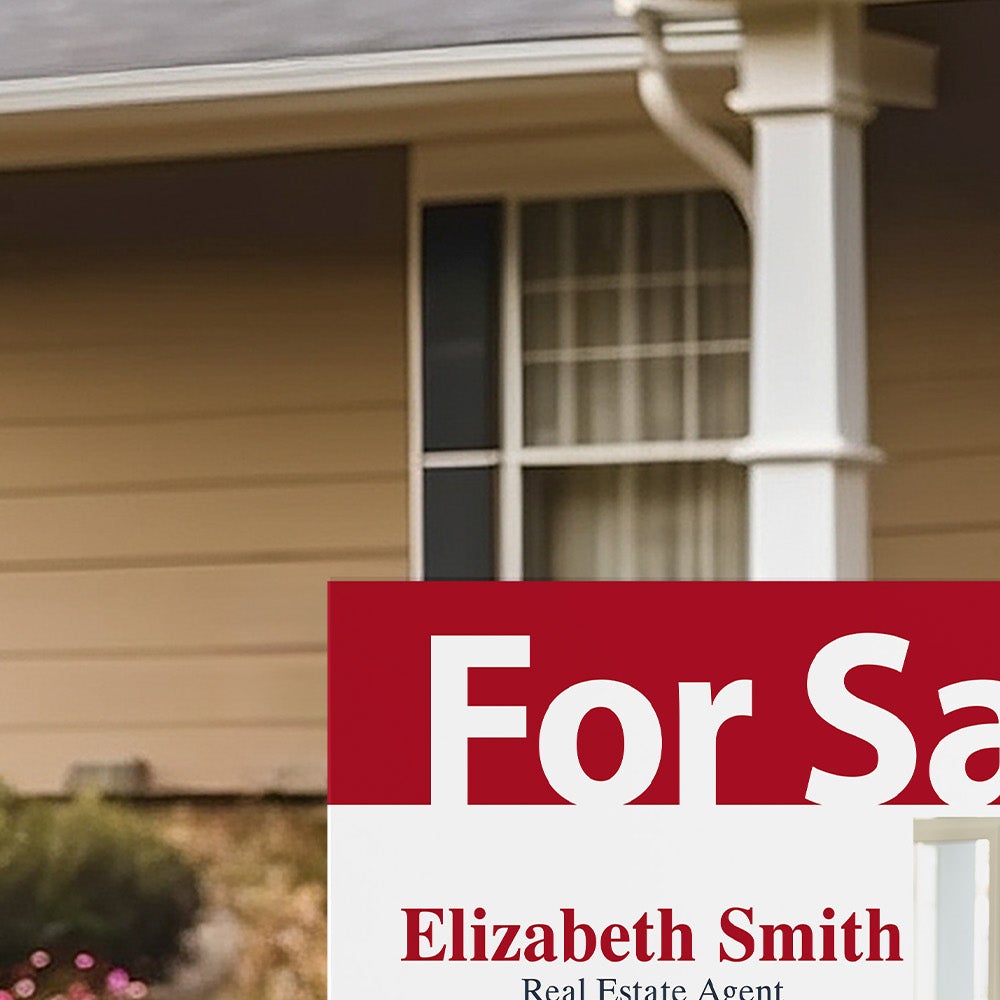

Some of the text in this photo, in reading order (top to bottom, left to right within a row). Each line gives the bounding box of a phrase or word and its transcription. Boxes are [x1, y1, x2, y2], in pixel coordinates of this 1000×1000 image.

[431, 636, 752, 805] For
[401, 907, 903, 962] Elizabeth Smith
